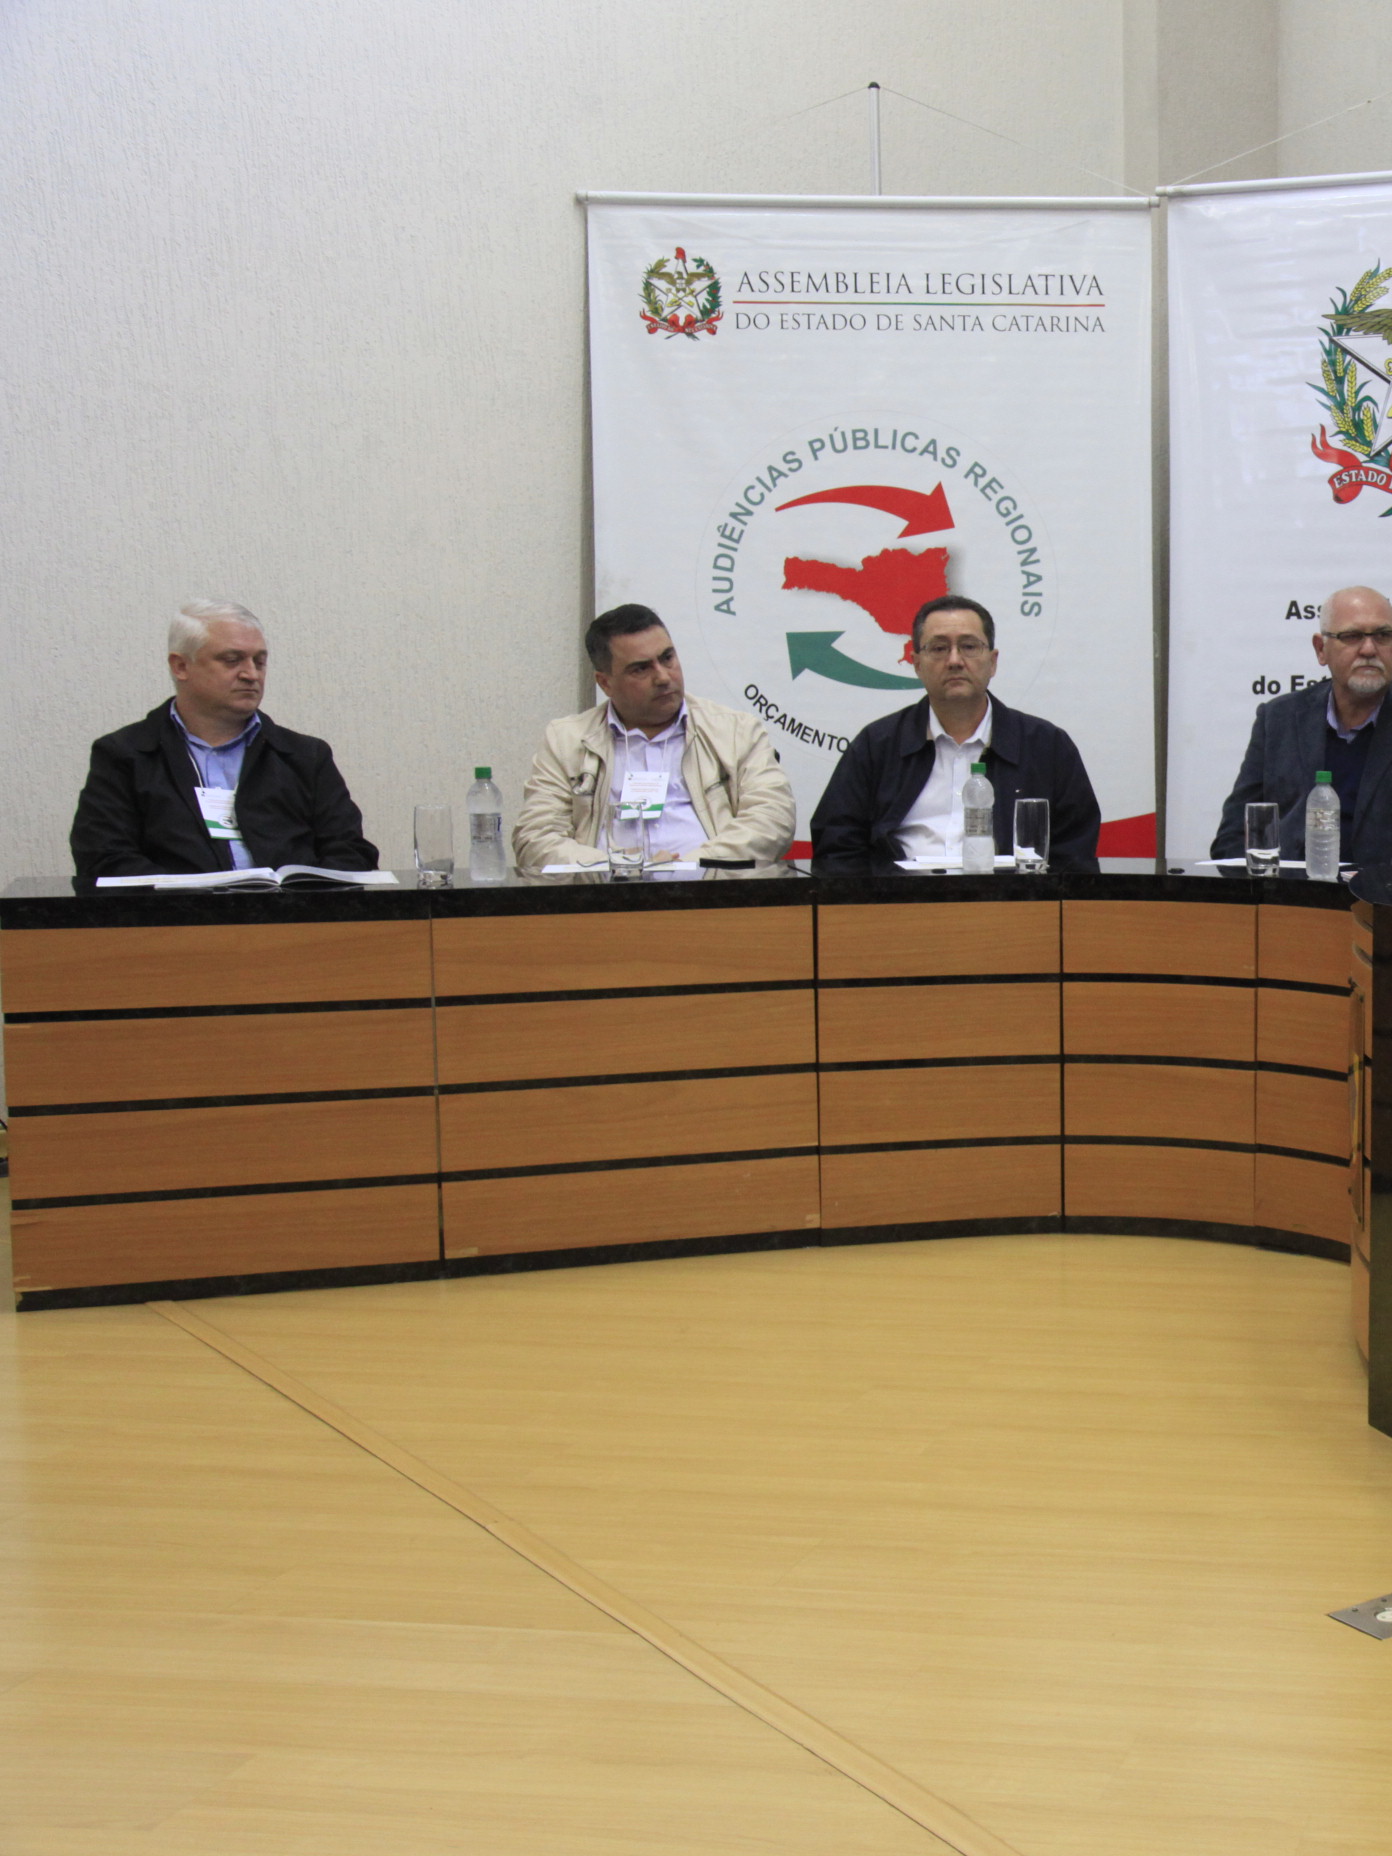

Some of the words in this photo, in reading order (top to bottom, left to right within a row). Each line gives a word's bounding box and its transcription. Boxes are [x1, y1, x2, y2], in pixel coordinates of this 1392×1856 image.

[737, 270, 913, 294] ASSEMBLEIA
[924, 272, 1105, 296] LEGISLATIVA
[735, 312, 770, 330] DO
[780, 313, 867, 331] ESTADO
[876, 313, 904, 331] DE
[913, 313, 984, 332] SANTA
[991, 314, 1106, 333] CATARINA
[1333, 469, 1387, 489] ESTADO
[712, 450, 803, 616] AUDIÊNCIAS
[807, 426, 962, 469] PÚBLICAS
[963, 461, 1043, 618] REGIONAIS
[1252, 675, 1281, 695] do
[743, 683, 850, 753] ORÇAMENTO
